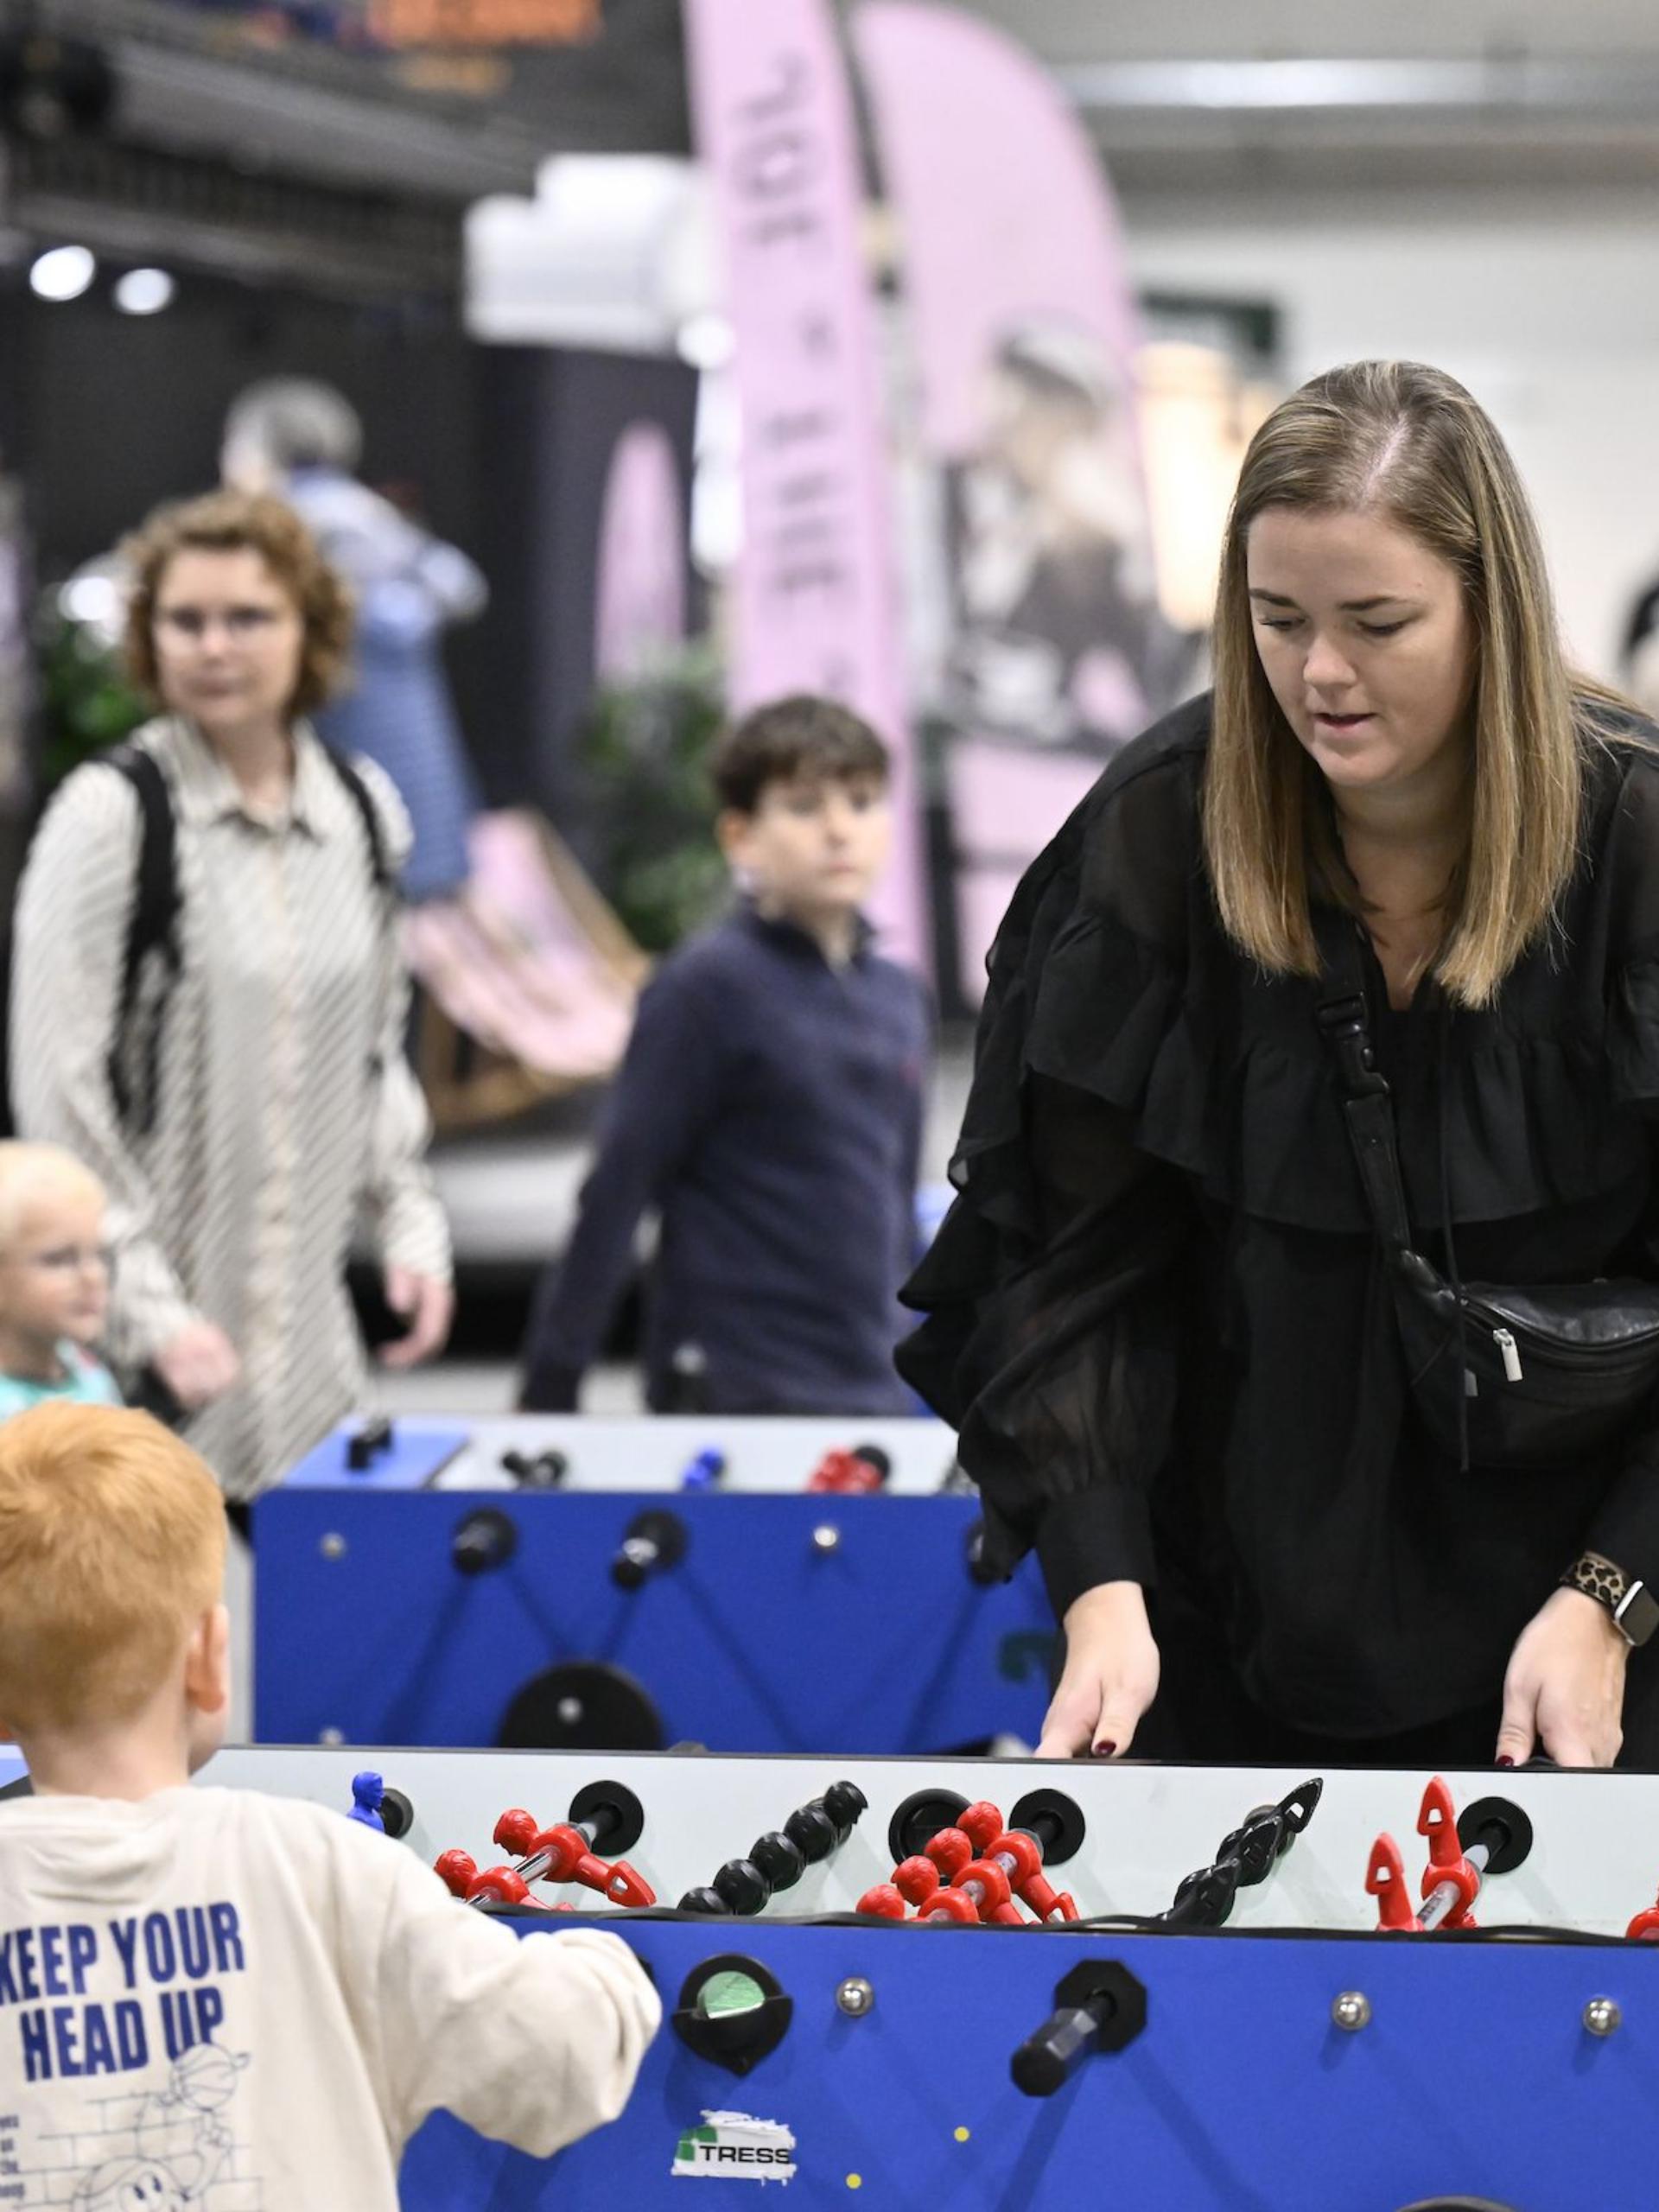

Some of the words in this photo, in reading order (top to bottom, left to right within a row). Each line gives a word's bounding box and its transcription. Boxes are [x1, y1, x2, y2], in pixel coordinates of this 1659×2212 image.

[109, 1902, 245, 1990] YOUR
[20, 1999, 149, 2082] HEAD
[159, 1986, 225, 2063] UP
[699, 2145, 791, 2164] TRESS
